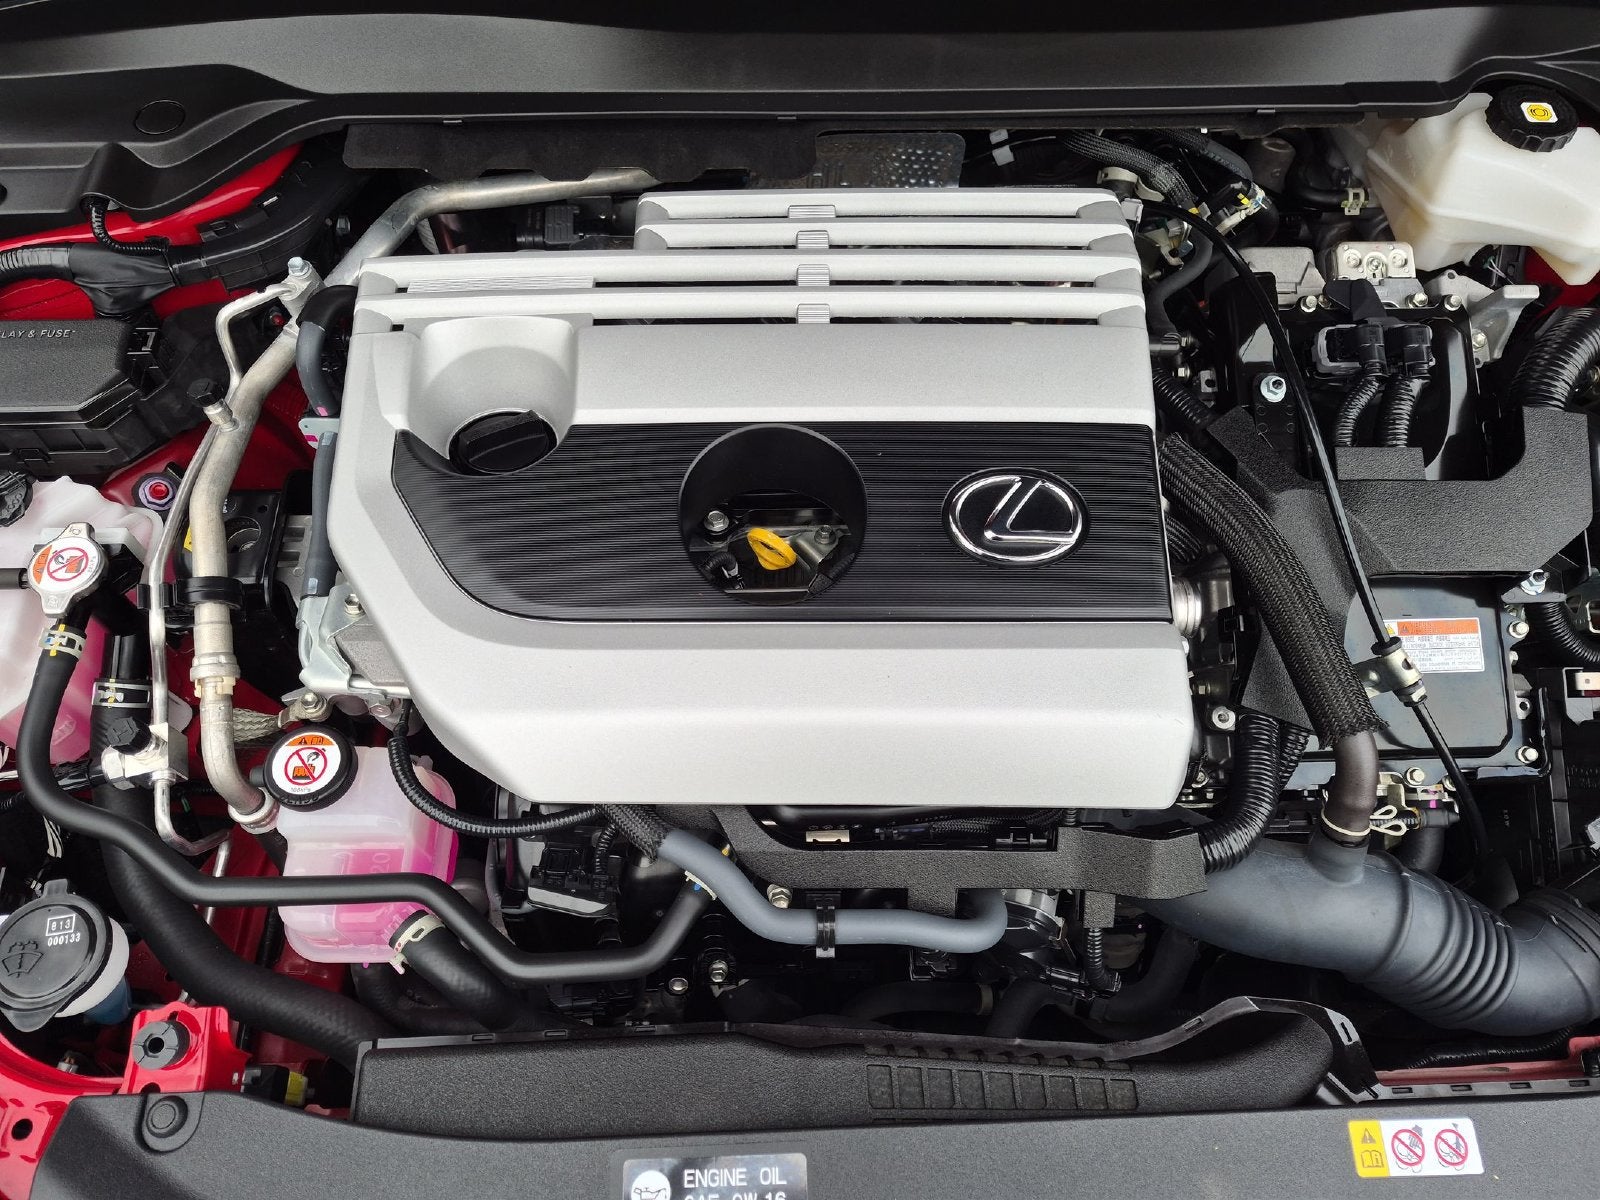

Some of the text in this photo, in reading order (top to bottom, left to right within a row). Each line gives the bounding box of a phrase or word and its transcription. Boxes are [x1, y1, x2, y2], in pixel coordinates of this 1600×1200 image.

[0, 329, 25, 338] LAY
[28, 329, 35, 338] &
[47, 932, 81, 947] 000133
[683, 1166, 788, 1188] ENGINE OIL
